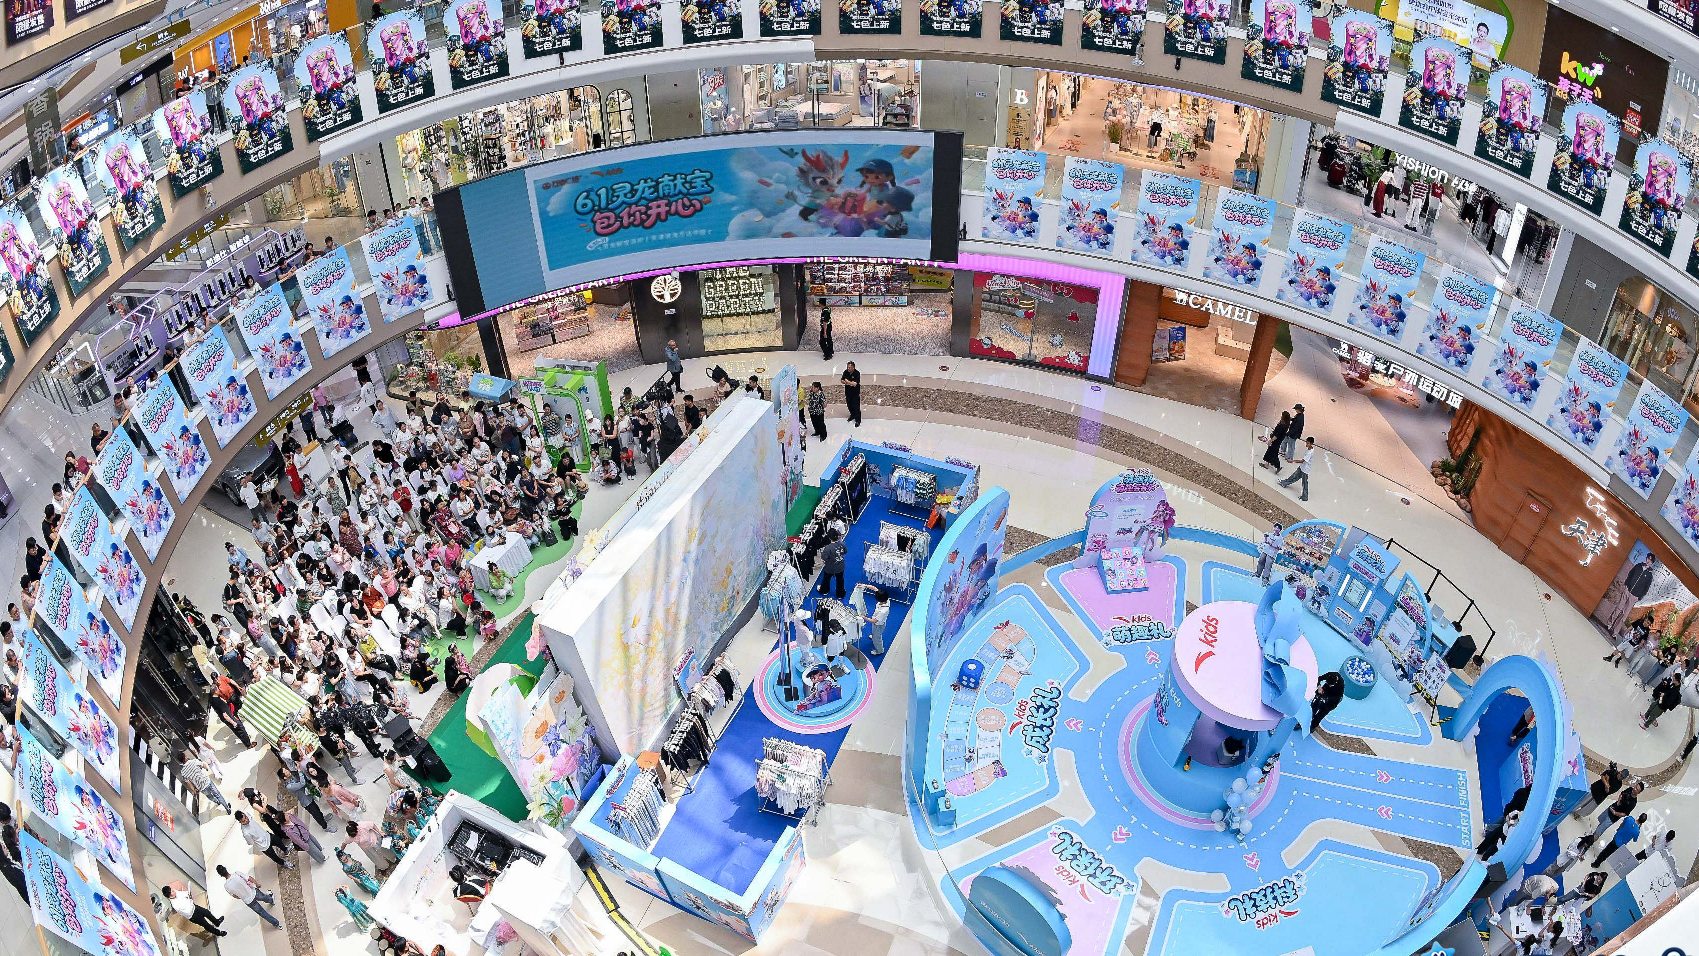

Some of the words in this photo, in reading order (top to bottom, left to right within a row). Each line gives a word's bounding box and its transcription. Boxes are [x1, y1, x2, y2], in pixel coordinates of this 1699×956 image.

[694, 25, 732, 38] 七色上新
[771, 21, 810, 31] 七色上新
[851, 19, 890, 29] 七色上新
[932, 21, 970, 32] 七色上新
[1011, 26, 1051, 39] 七色上新
[534, 38, 571, 52] 七色上新
[615, 35, 652, 48] 七色上新
[1094, 37, 1132, 50] 七色上新
[1176, 41, 1215, 57] 七色上新
[463, 65, 499, 81] 七色上新
[1255, 67, 1292, 85] 七色上新
[389, 87, 424, 104] 七色上新
[1333, 91, 1371, 109] 七色上新
[317, 112, 351, 132] 七色上新
[1411, 116, 1448, 137] 七色上新
[249, 143, 283, 163] 七色上新
[1487, 147, 1522, 168] 七色上新
[575, 169, 714, 215] 6.1灵龙献宝
[1559, 180, 1594, 204] 七色上新
[592, 197, 702, 235] 包你开心
[1630, 220, 1664, 246] 七色上新
[1188, 294, 1257, 325] CAMEL
[1132, 615, 1152, 624] kids
[1111, 622, 1172, 643] 萌趣礼
[1199, 615, 1219, 648] kids
[1014, 699, 1029, 720] kids
[1022, 687, 1062, 754] 成长礼
[1456, 772, 1468, 807] FINISH
[1460, 812, 1471, 847] START
[1054, 864, 1080, 886] kids
[1228, 879, 1298, 921] 科技礼
[1256, 912, 1278, 930] kids
